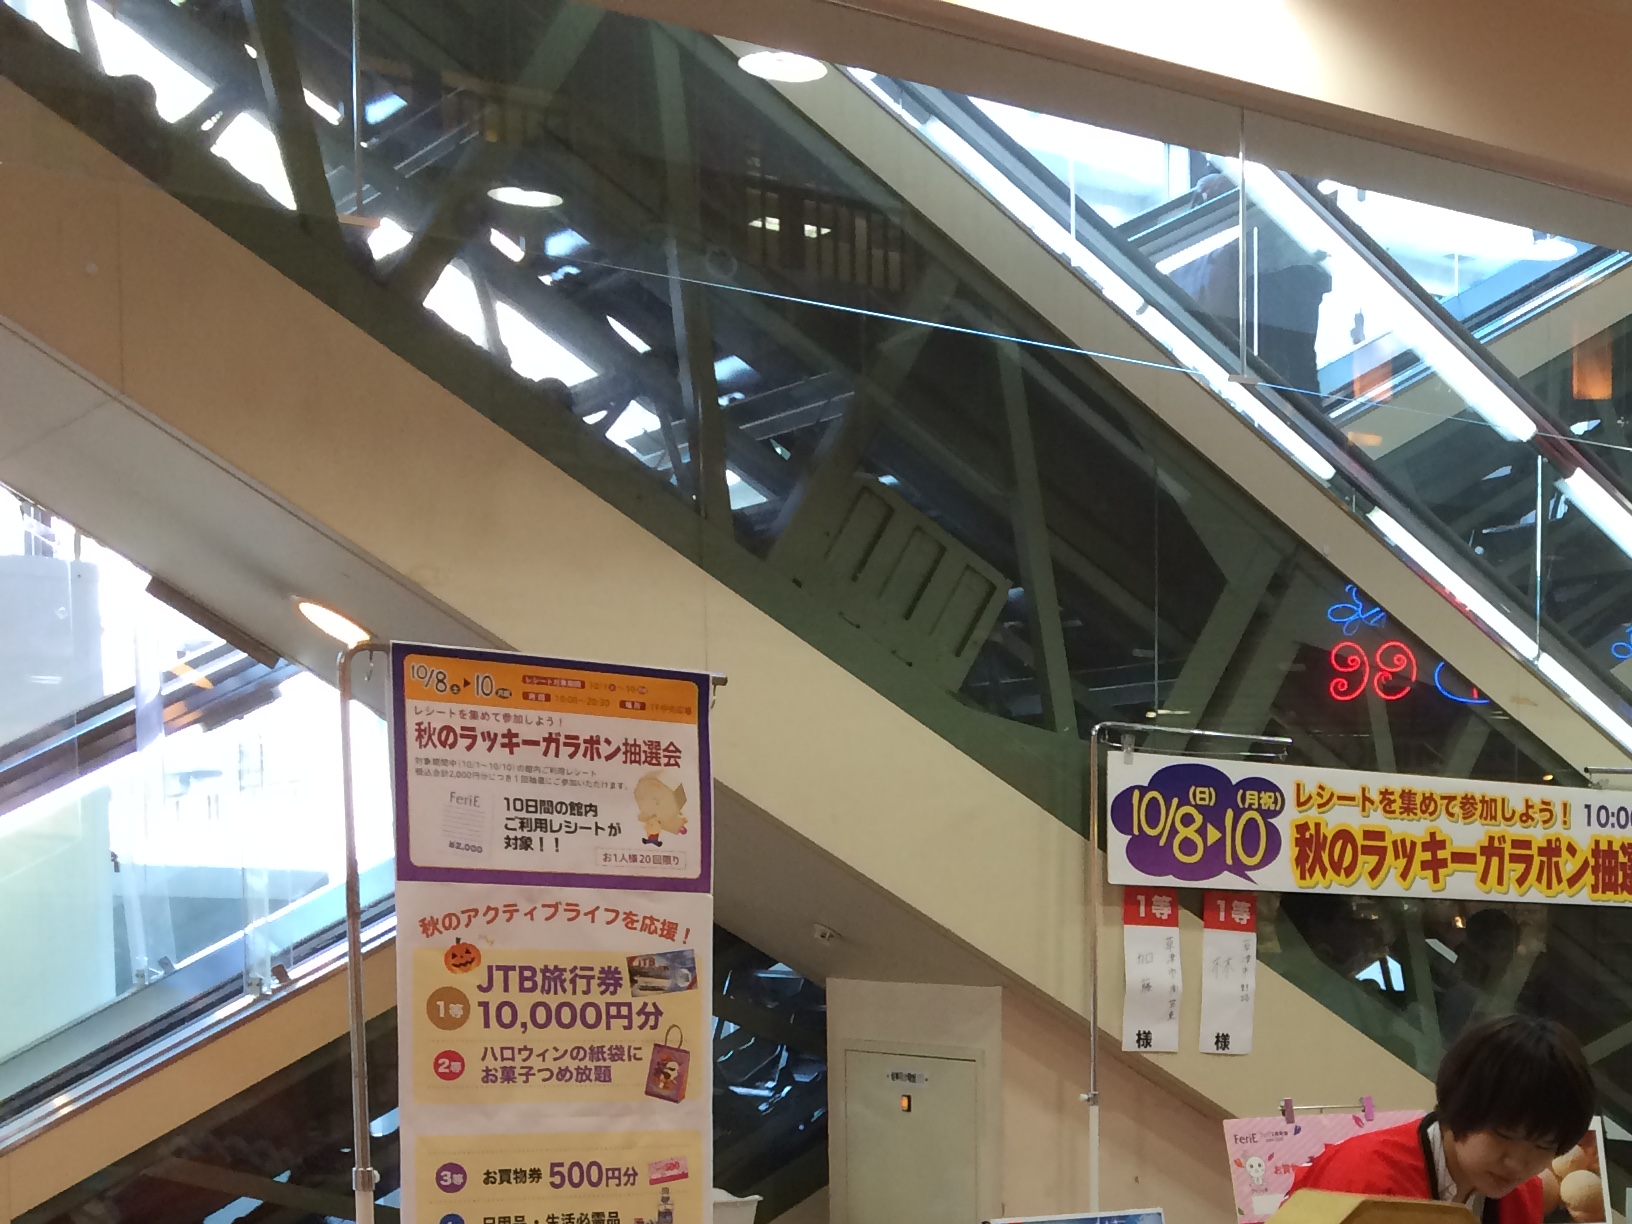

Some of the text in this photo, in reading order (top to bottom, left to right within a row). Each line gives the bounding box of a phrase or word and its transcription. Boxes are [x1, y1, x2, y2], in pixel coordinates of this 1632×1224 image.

[410, 664, 448, 693] 10/8
[475, 674, 493, 696] 10
[414, 705, 563, 727] レシートを集めて参加しよう！
[414, 721, 682, 769] 秋のラッキーガラポン抽選会
[504, 797, 599, 818] 10日間の館内
[1294, 781, 1570, 827] レシートを集めて参加しよう！
[504, 816, 622, 837] ご利用レシートが
[1132, 788, 1204, 864] 10/8
[1225, 808, 1267, 866] 10
[504, 835, 560, 853] 対象！！
[1137, 895, 1173, 919] 1等
[1217, 900, 1251, 925] 1等
[418, 902, 691, 944] 秋のアクティブライフを応援！
[476, 965, 624, 996] JTB旅行券
[477, 1001, 664, 1034] 10,000円分
[1136, 1030, 1153, 1049] 様
[1214, 1033, 1231, 1051] 様
[480, 1045, 644, 1063] ハロウィンの紙袋に
[480, 1064, 613, 1084] お菓子つめ放題
[1233, 1132, 1258, 1145] FeriE
[482, 1160, 638, 1189] お買物券 500円分
[1273, 1163, 1299, 1175] お買
